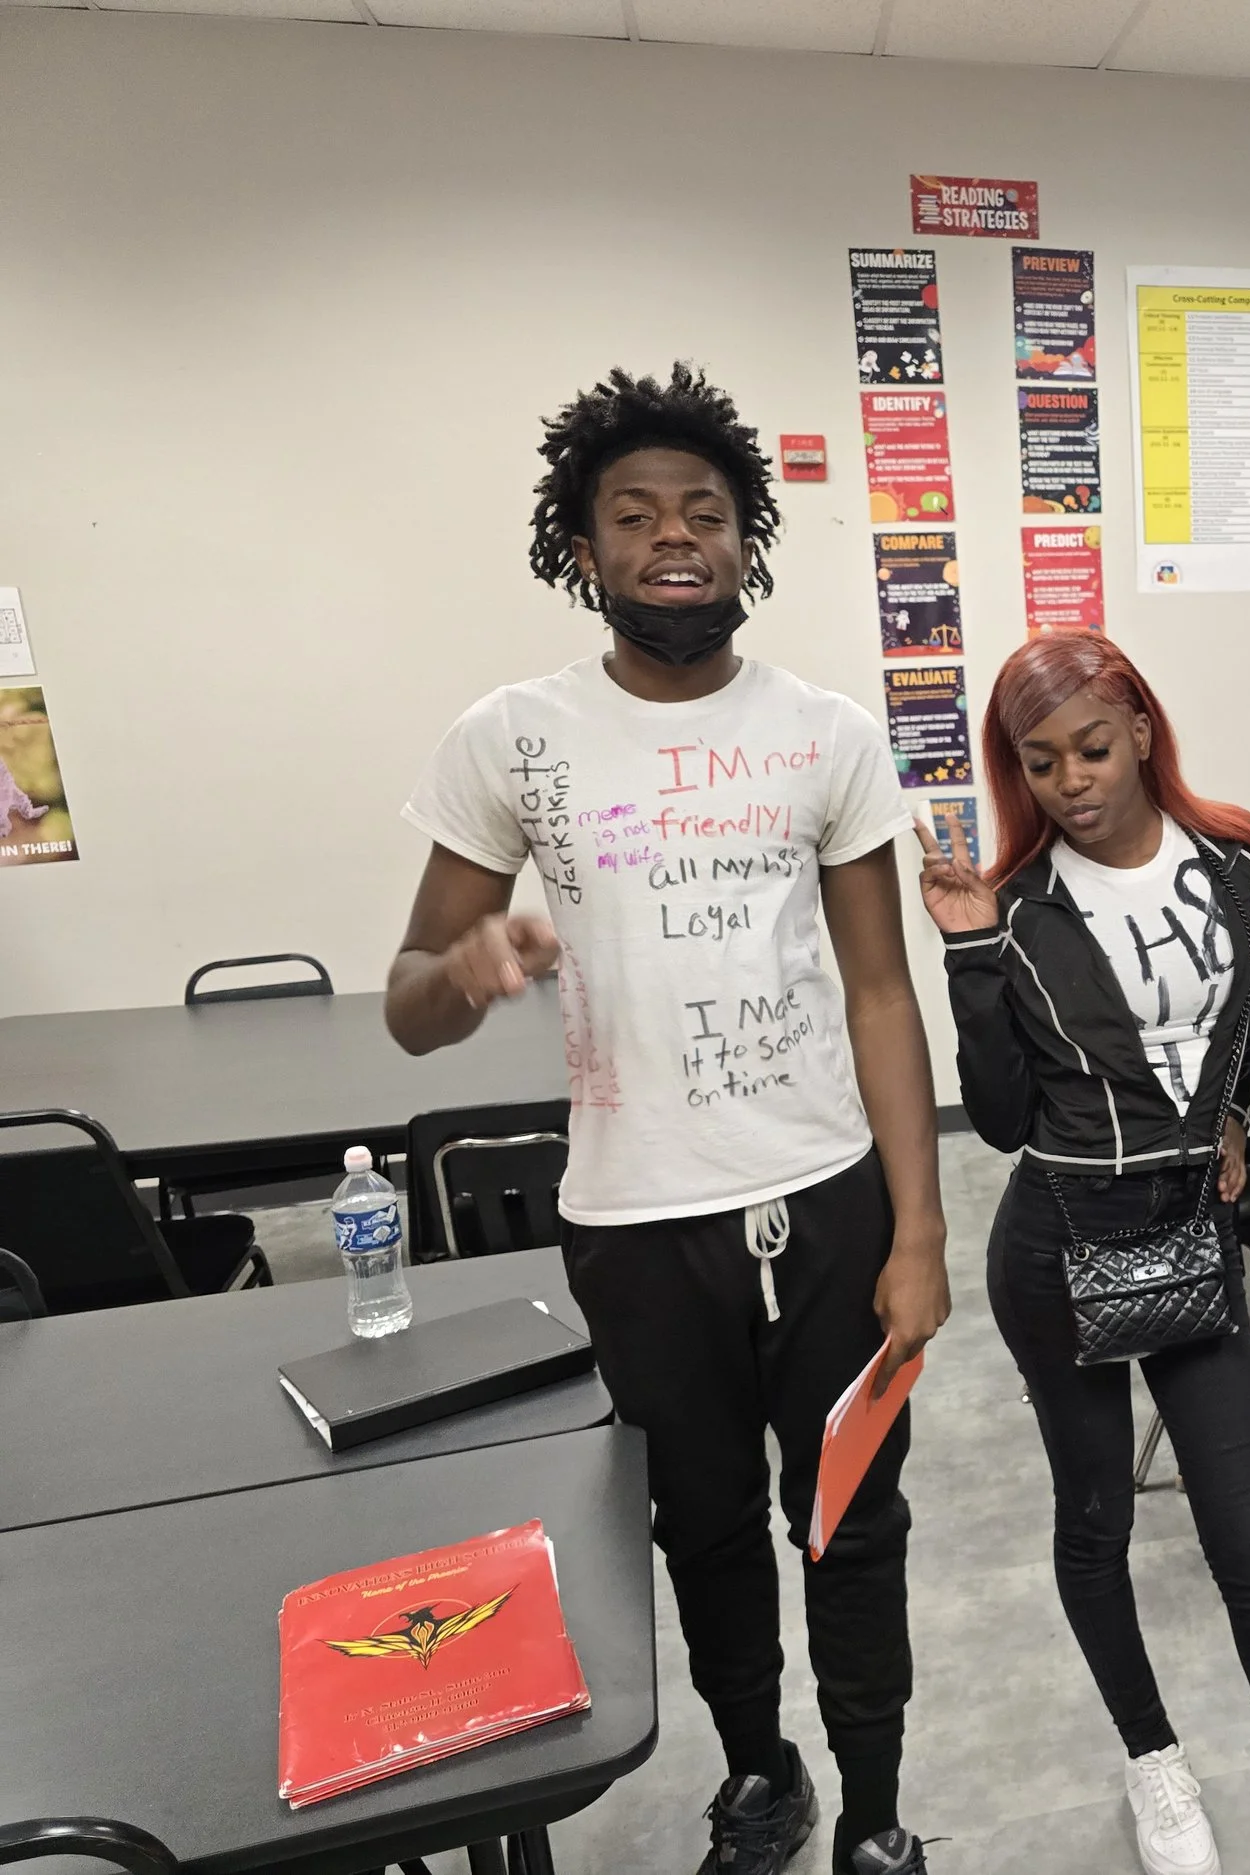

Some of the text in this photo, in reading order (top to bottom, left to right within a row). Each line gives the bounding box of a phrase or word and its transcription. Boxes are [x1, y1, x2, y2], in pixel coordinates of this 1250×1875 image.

[942, 186, 1005, 207] READING
[943, 208, 1029, 230] STRATEGIES
[850, 252, 934, 269] SUMMARIZE
[1023, 255, 1080, 272] PREVIEW
[1172, 293, 1226, 305] Cross-Cutting
[872, 396, 931, 411] IDENTIFY
[1027, 394, 1088, 409] QUESTION
[881, 535, 944, 551] COMPARE
[1033, 533, 1084, 548] PREDICT
[892, 670, 957, 687] EVALUATE
[764, 741, 820, 776] not
[932, 802, 965, 816] NECT
[623, 820, 650, 838] not
[1, 840, 72, 856] IN THERE!
[661, 904, 751, 940] Loyal
[684, 999, 725, 1040] I
[715, 1037, 748, 1070] to
[687, 1070, 797, 1107] on time
[298, 1567, 413, 1607] INNOVATIONS
[416, 1554, 461, 1576] HIGH
[394, 1580, 408, 1592] of
[408, 1577, 426, 1587] the
